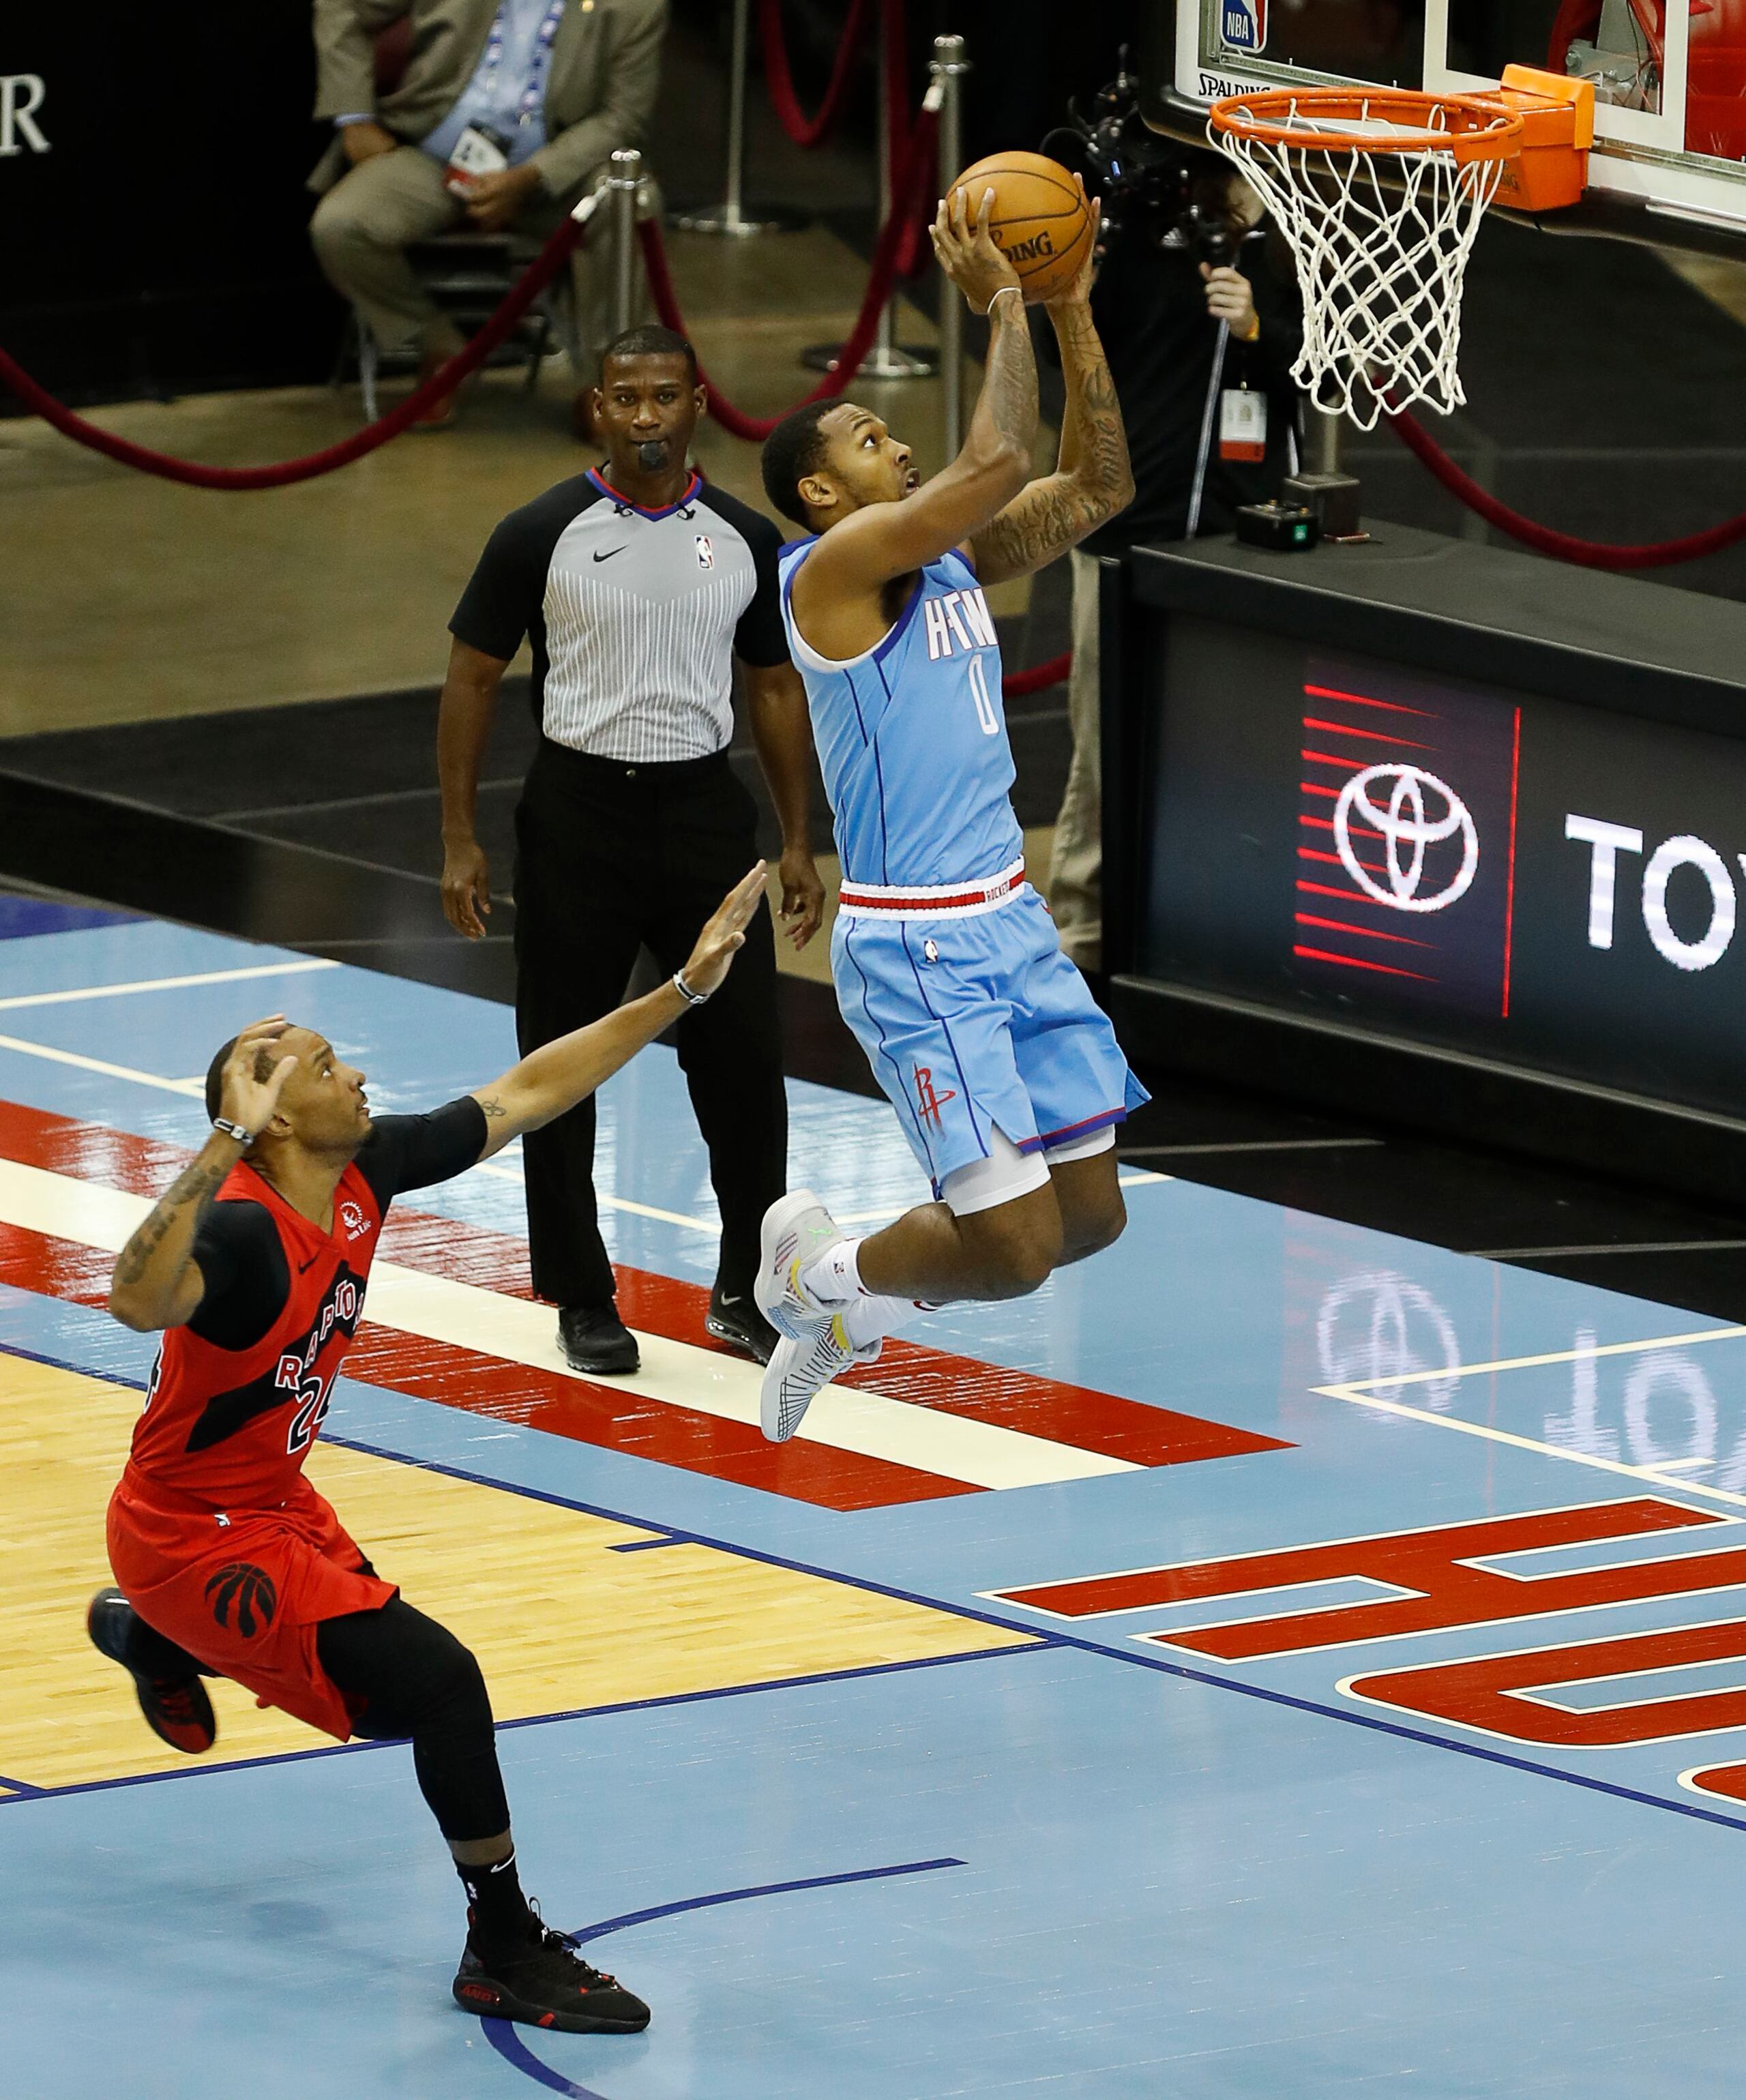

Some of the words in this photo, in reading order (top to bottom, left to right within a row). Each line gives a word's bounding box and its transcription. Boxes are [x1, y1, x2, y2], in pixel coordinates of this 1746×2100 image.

[1227, 12, 1249, 40] NBA
[0, 73, 52, 156] R
[968, 653, 999, 735] 0
[1565, 813, 1746, 971] TO
